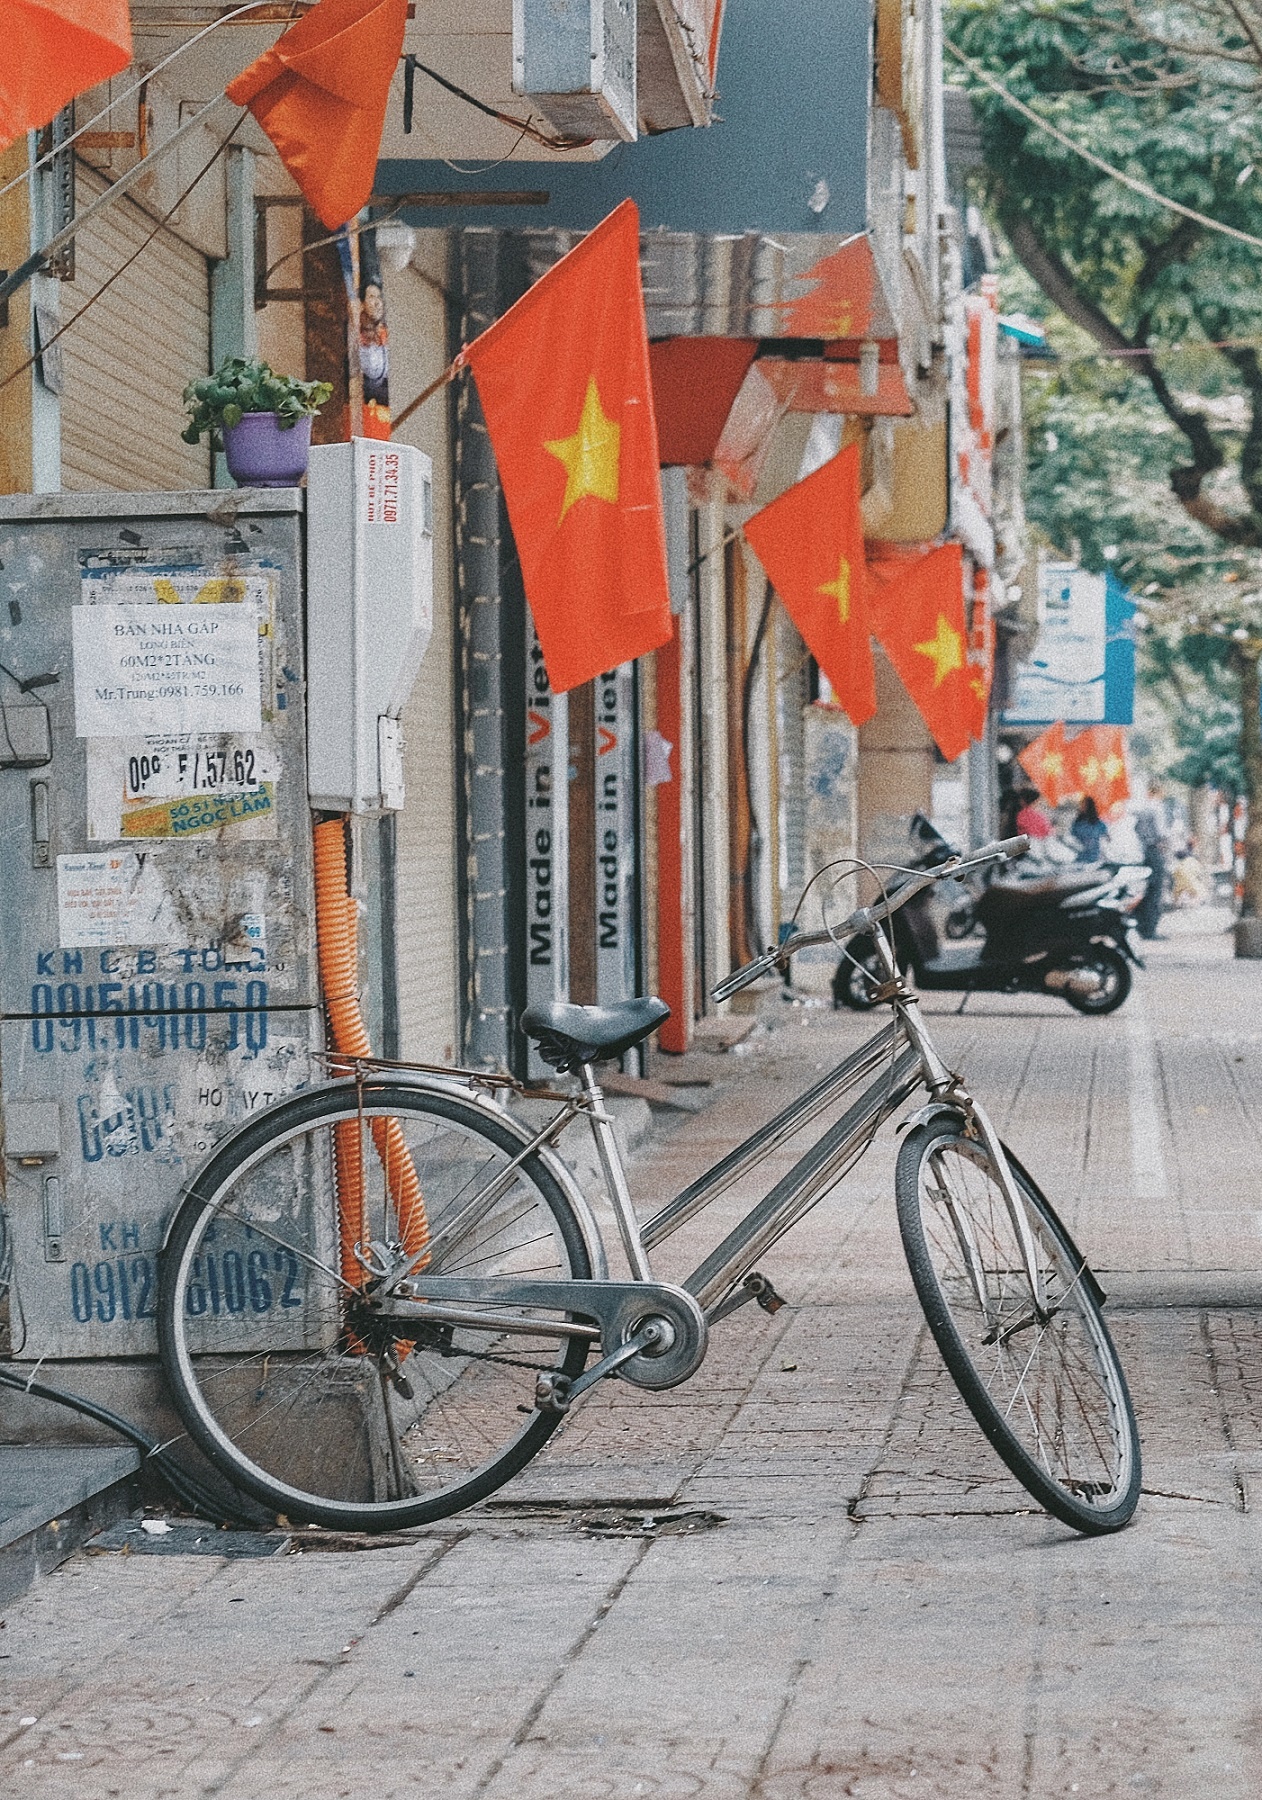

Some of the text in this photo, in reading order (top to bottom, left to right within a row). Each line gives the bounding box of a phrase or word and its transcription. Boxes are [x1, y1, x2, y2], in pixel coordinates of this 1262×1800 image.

[384, 454, 399, 522] 0971.71.34.35
[172, 808, 227, 833] NGỌC
[230, 797, 271, 817] LÂM
[528, 628, 551, 966] Made in Viet
[598, 772, 618, 811] in
[599, 826, 618, 950] Made
